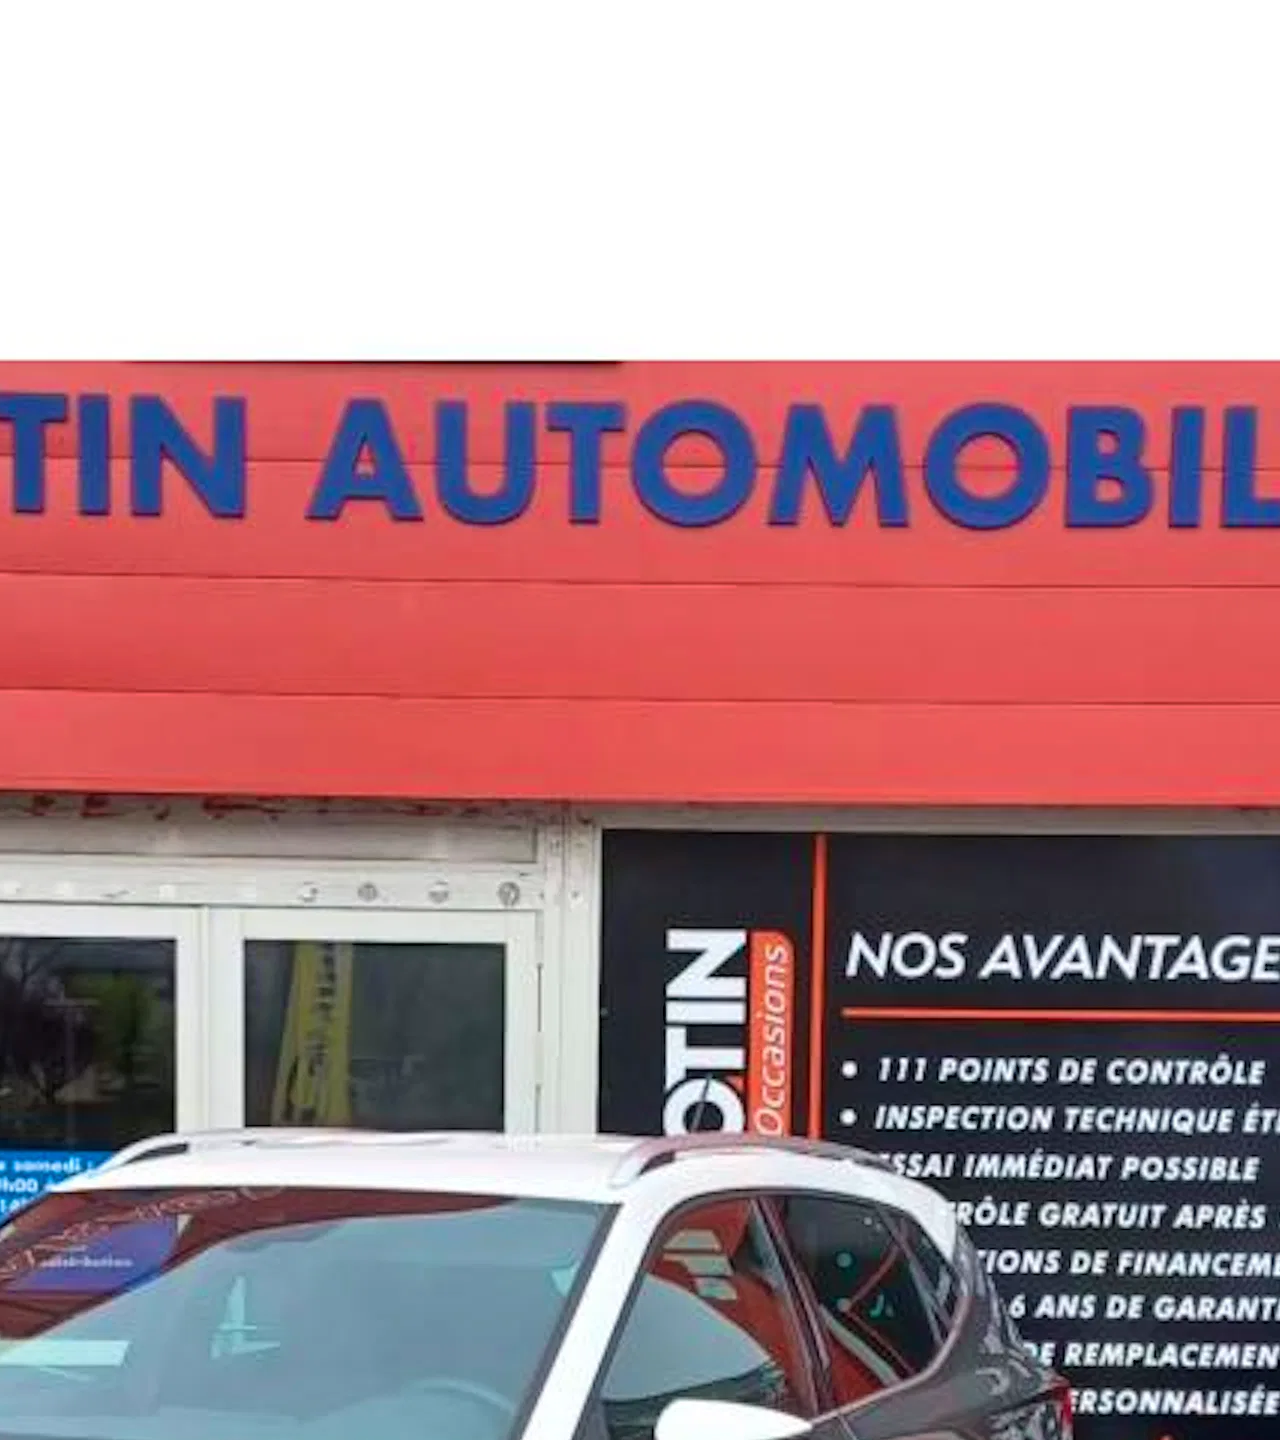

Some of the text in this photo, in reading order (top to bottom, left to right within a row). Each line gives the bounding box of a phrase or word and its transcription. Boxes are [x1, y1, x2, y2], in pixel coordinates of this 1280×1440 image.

[845, 931, 968, 979] NOS
[663, 928, 746, 1138] OTIN
[753, 943, 790, 1137] Occasions
[879, 1053, 1266, 1086] 111 POINTS DE CONTRÔLE
[874, 1105, 1055, 1131] INSPECTION
[1064, 1107, 1235, 1135] TECHNIQUE
[13, 1156, 81, 1173] samedi
[880, 1147, 1260, 1182] SSAI IMMÉDIAT POSSIBLE
[951, 1195, 1031, 1227] RÔLE
[1038, 1201, 1168, 1229] GRATUIT
[1172, 1198, 1267, 1230] APRÈS
[977, 1249, 1062, 1275] IONS
[1069, 1250, 1109, 1275] DE
[1009, 1294, 1026, 1319] 6
[1034, 1294, 1097, 1319] ANS
[1105, 1294, 1145, 1319] DE
[1070, 1384, 1280, 1415] ERSONNALISÉE
